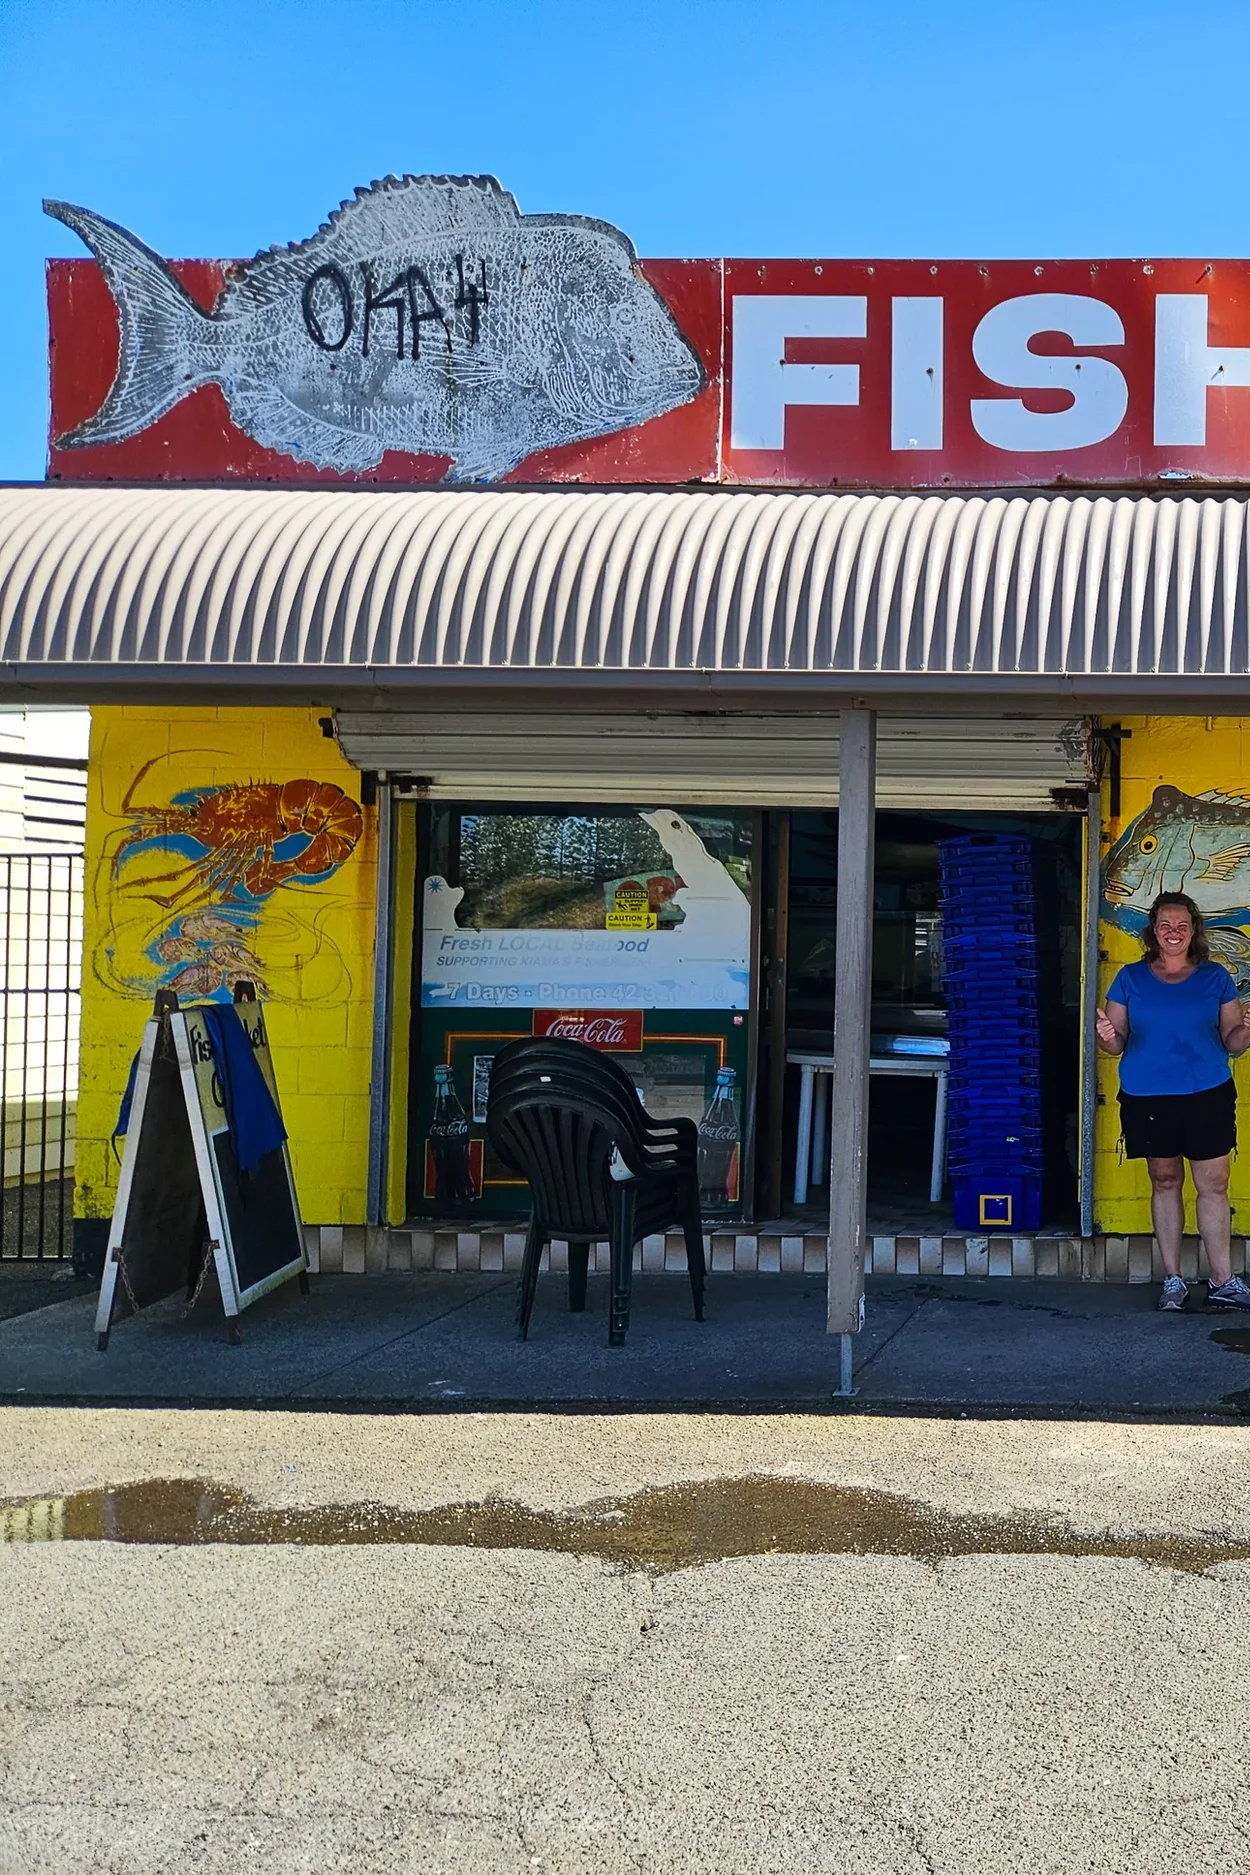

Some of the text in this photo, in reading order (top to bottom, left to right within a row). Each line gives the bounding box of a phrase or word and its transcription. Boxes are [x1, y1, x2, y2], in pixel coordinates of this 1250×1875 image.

[440, 936, 492, 950] Fresh
[498, 936, 564, 950] LOCAL
[436, 956, 517, 966] SUPPORTING
[467, 982, 520, 1004] Days
[539, 982, 606, 1001] Phone
